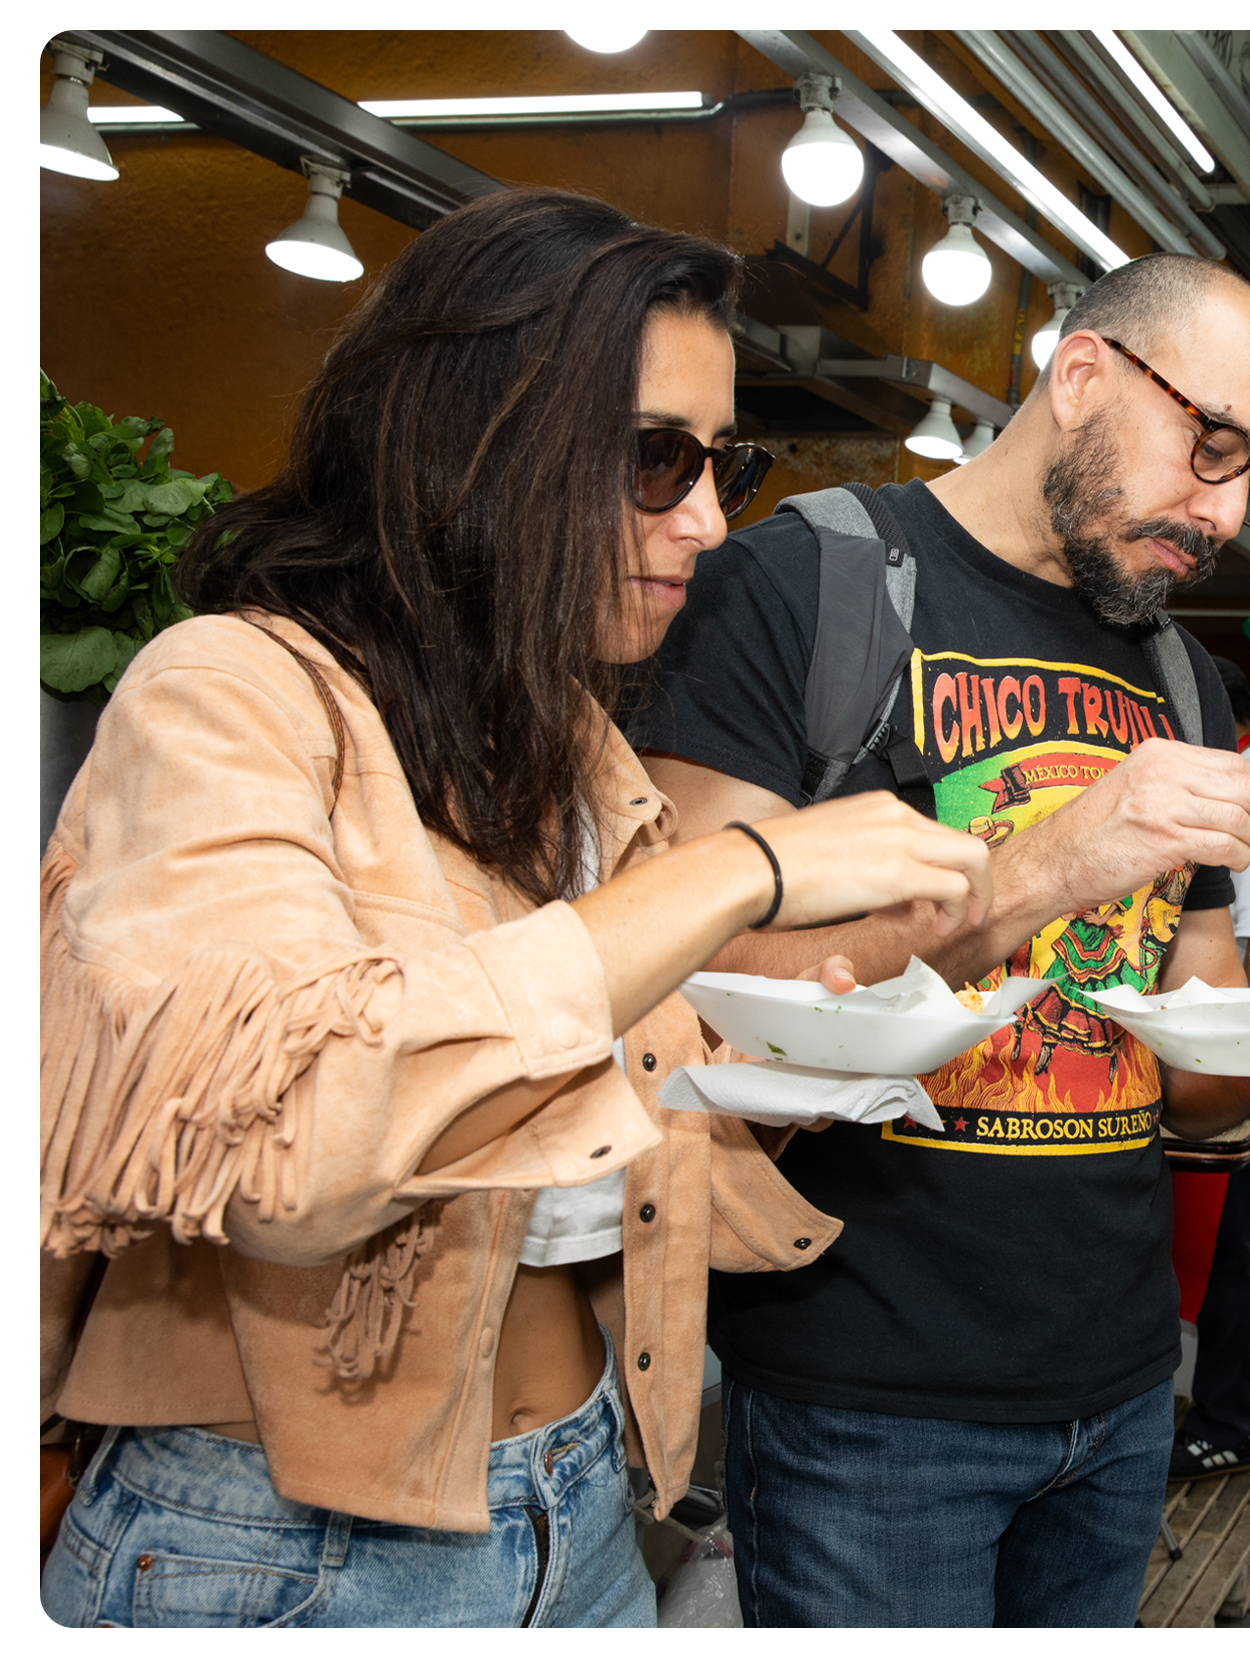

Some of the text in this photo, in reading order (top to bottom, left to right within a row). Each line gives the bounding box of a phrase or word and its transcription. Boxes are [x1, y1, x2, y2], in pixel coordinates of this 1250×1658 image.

[932, 672, 1047, 764] CHICO
[1024, 764, 1078, 785] MÉXICO
[976, 1109, 1153, 1140] SABROSON SUREÑO
